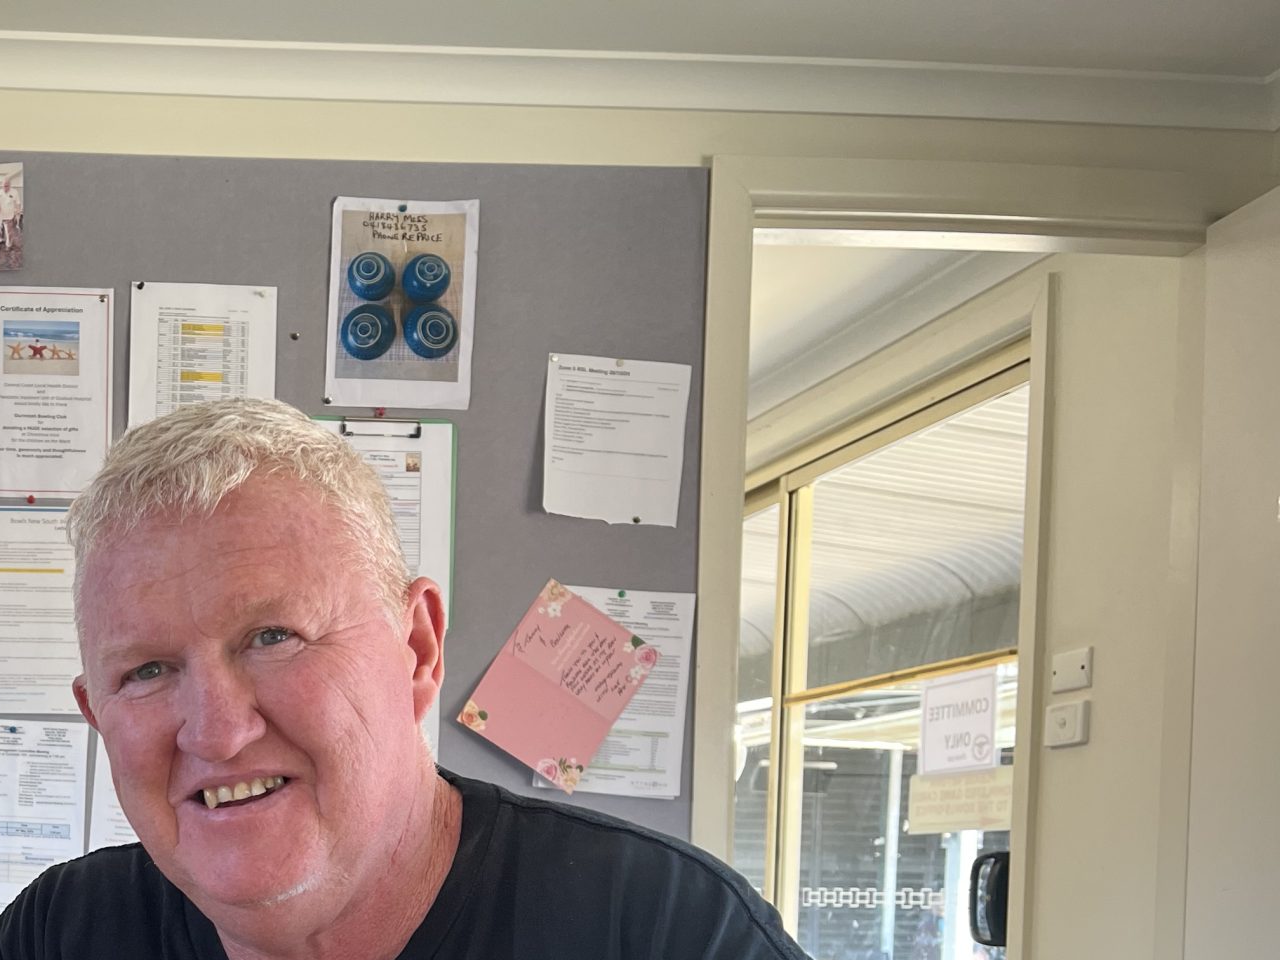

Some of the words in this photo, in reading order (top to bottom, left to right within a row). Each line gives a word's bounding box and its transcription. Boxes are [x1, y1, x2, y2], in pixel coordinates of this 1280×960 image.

[368, 211, 399, 222] HARRY
[372, 230, 399, 240] PHONE
[416, 232, 443, 242] PRICE
